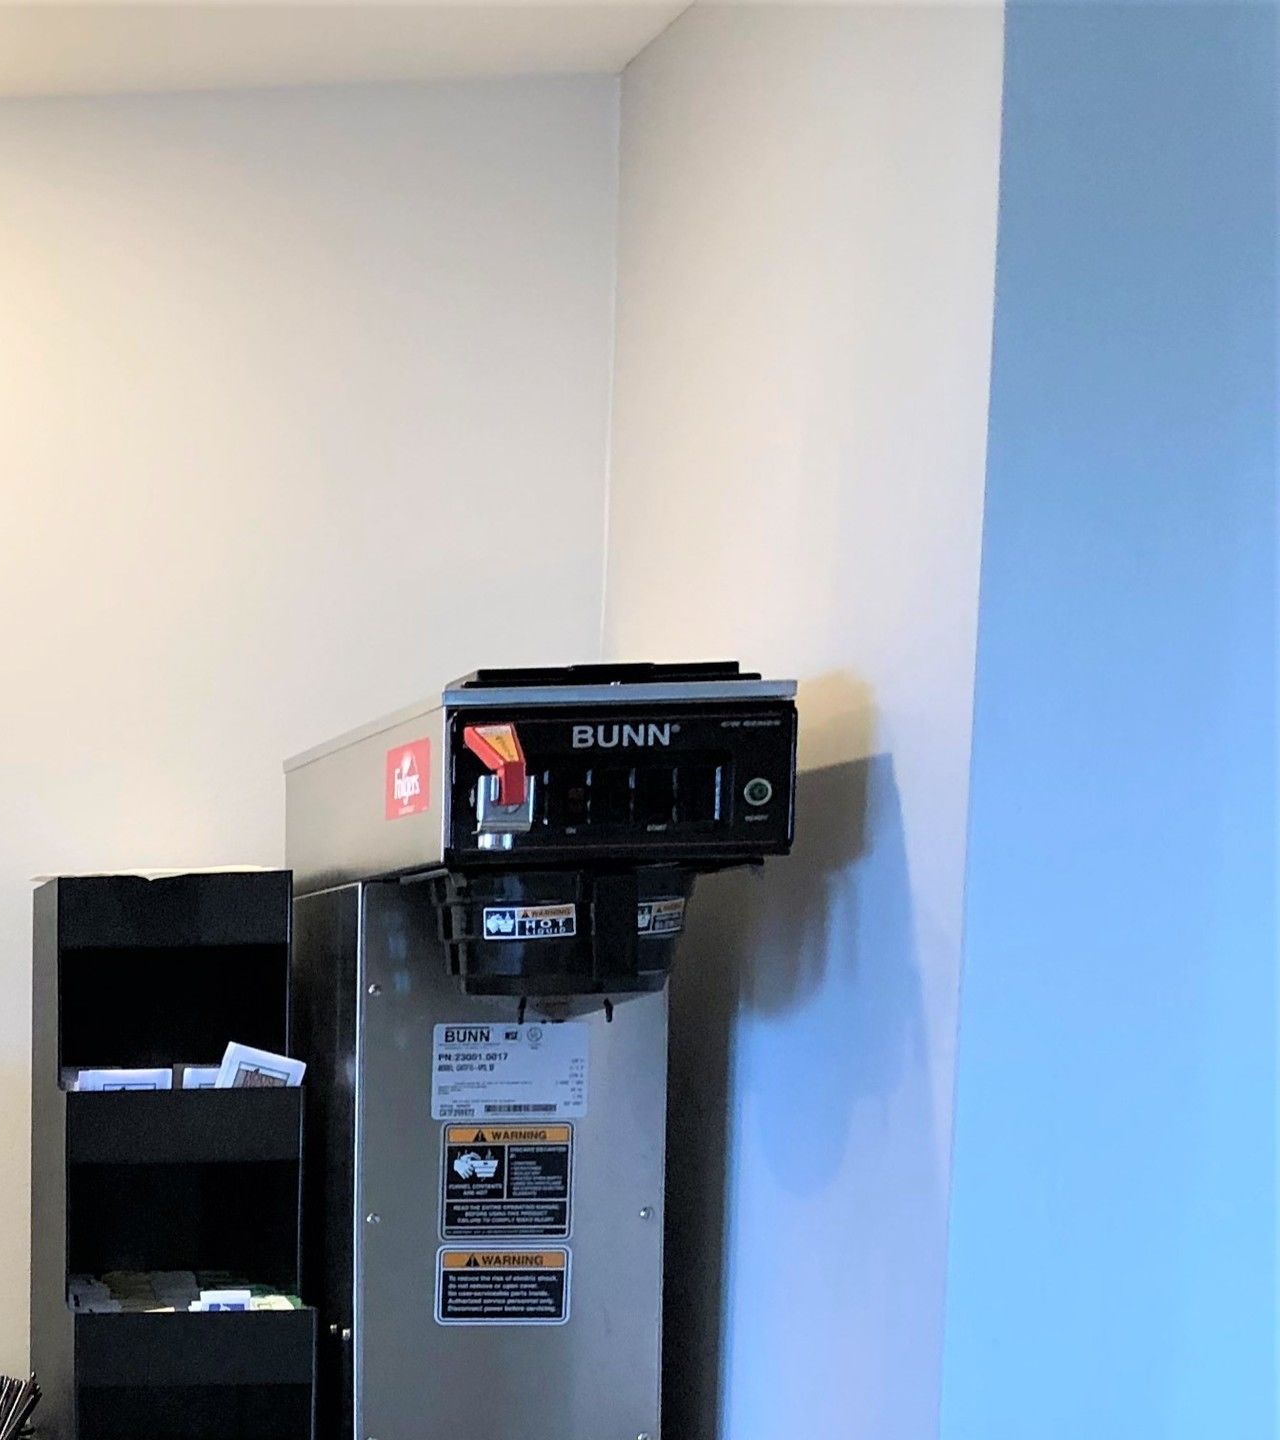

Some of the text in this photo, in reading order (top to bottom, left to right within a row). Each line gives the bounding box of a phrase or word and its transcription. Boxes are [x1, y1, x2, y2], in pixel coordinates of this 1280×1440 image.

[572, 722, 671, 749] BUNN
[526, 917, 566, 928] HOT
[444, 1030, 491, 1043] BUNN
[491, 1130, 547, 1140] WARNING
[481, 1255, 544, 1266] WARNING
